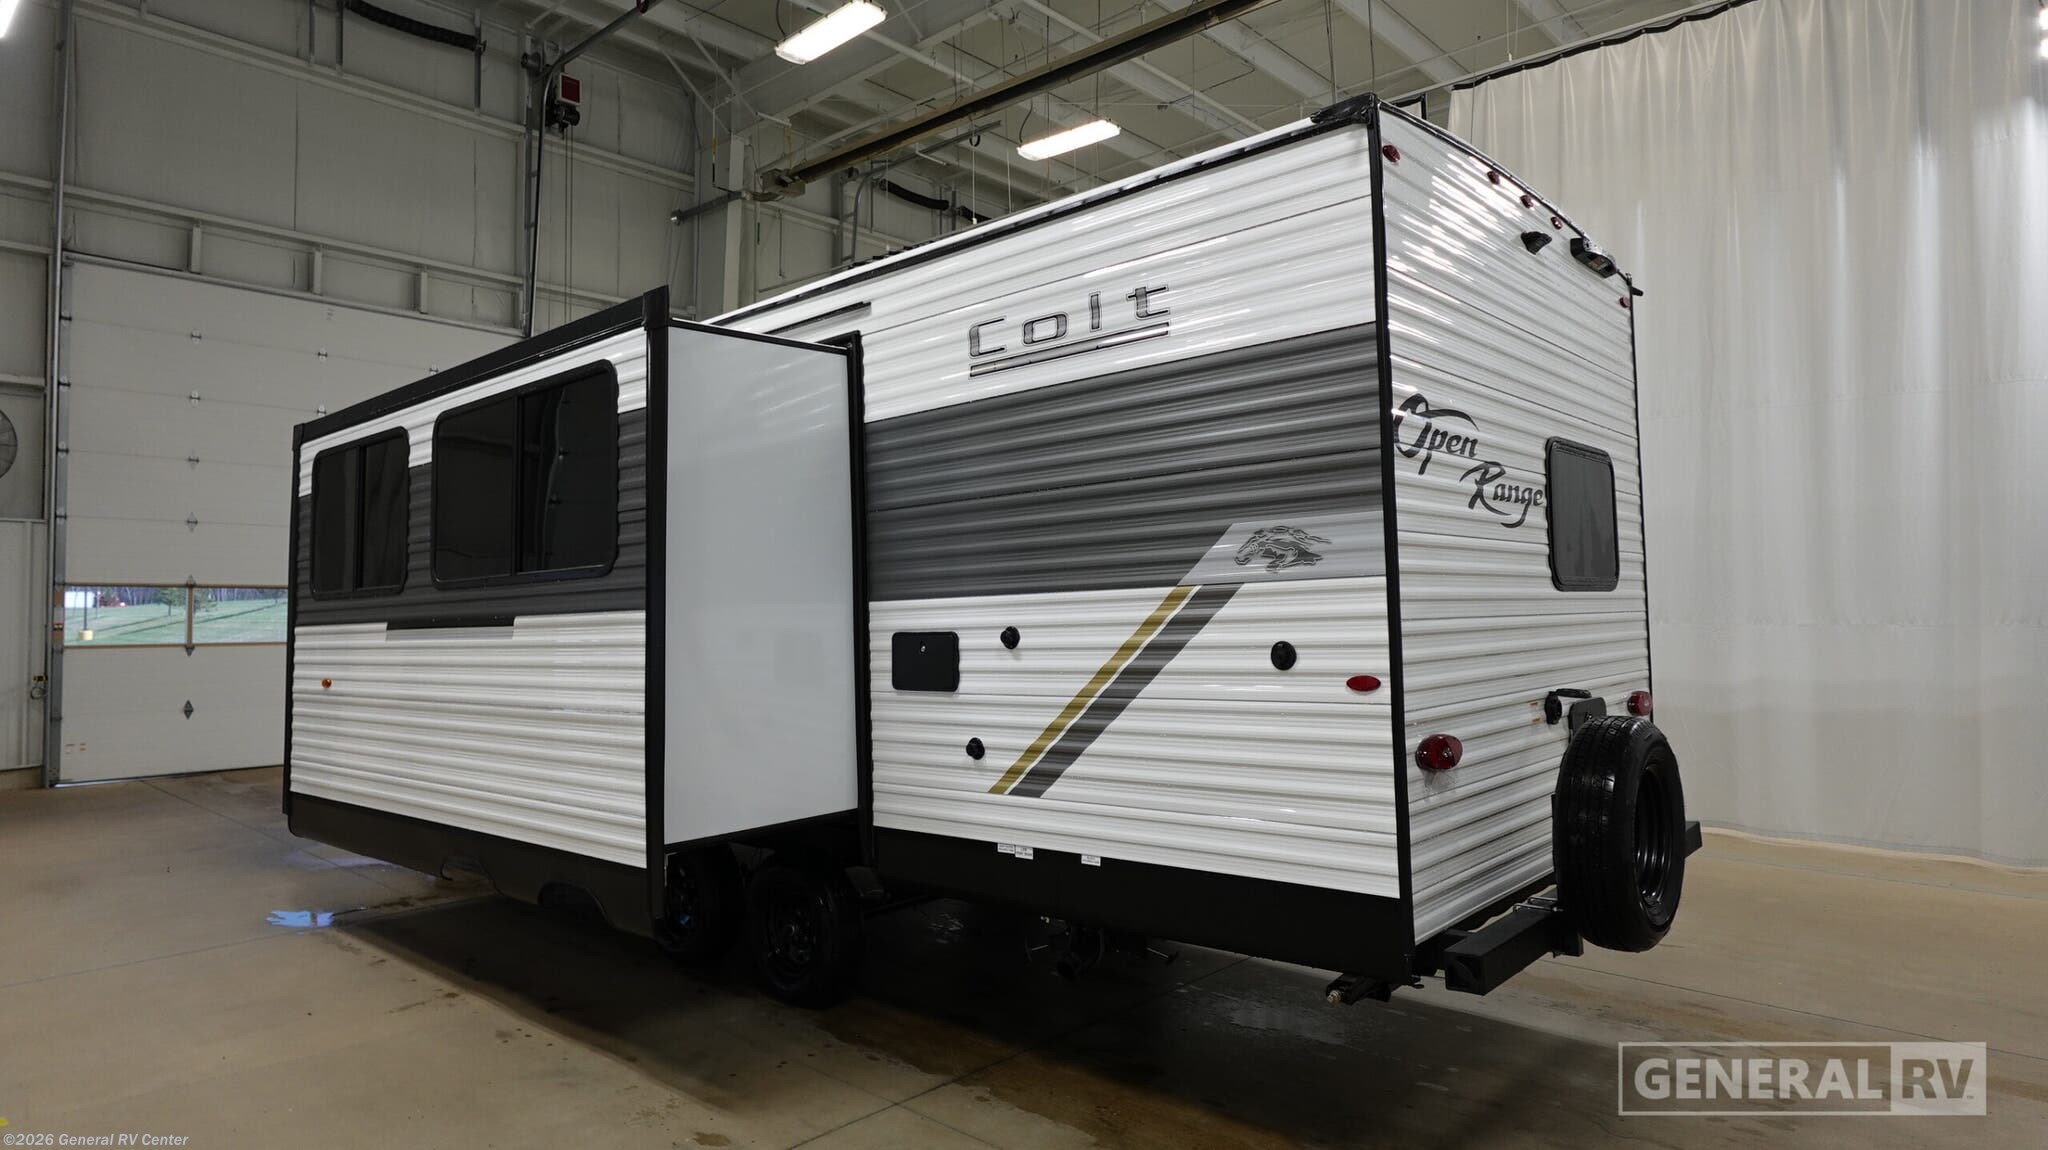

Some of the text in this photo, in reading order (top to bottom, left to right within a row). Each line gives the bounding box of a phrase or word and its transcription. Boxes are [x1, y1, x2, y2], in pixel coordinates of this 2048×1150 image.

[968, 285, 1170, 358] Colt
[1393, 393, 1480, 475] Open
[1459, 461, 1544, 529] Range
